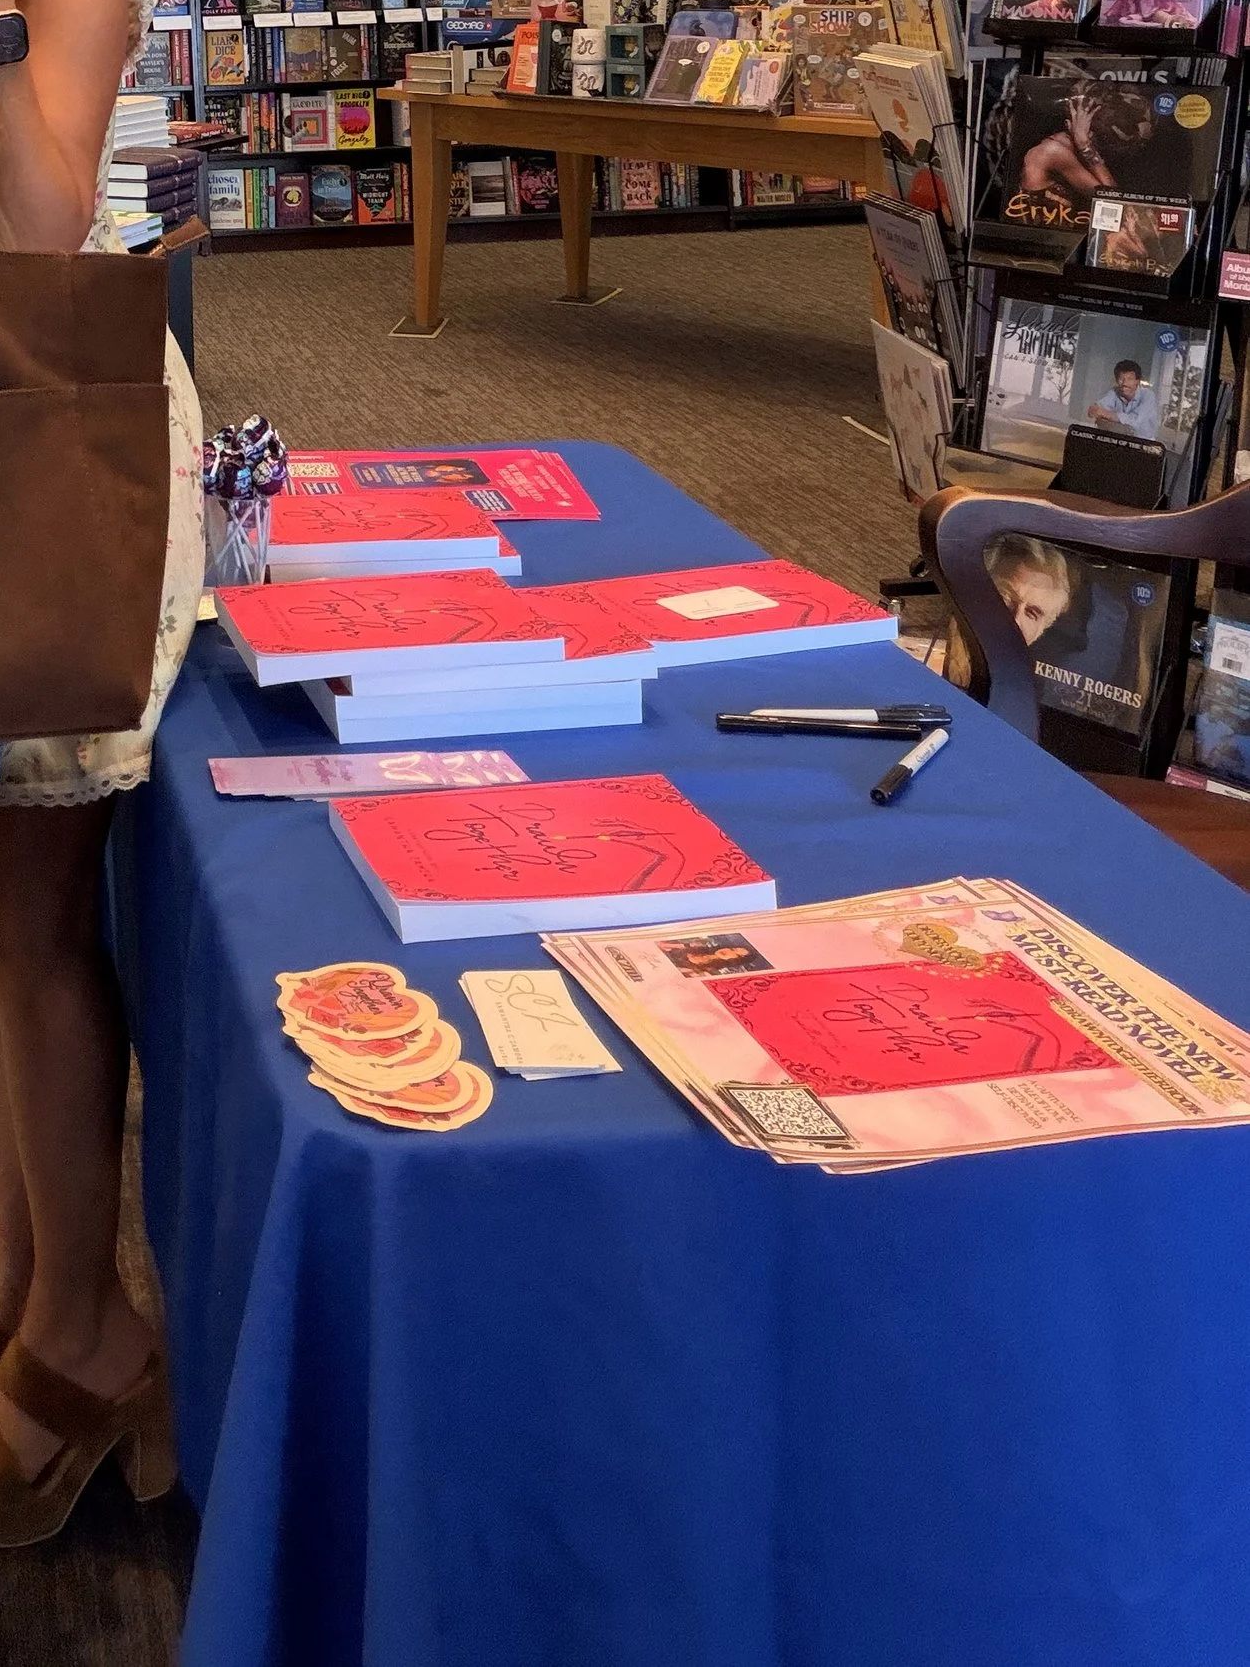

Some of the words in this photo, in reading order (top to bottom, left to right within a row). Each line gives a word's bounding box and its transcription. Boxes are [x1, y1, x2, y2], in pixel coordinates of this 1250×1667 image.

[820, 10, 855, 22] SHIP
[1002, 5, 1074, 20] MADONNA
[446, 20, 485, 30] GEOMAG
[215, 45, 237, 56] DICE
[208, 184, 240, 196] family
[626, 192, 653, 202] BACK
[1005, 192, 1091, 225] Eryka
[1226, 263, 1250, 273] Albu
[1034, 661, 1082, 689] KENNY
[1083, 676, 1142, 709] ROGERS
[1010, 933, 1130, 1024] MUST-READ
[1120, 1022, 1205, 1084] NOVEL
[1027, 928, 1139, 1007] DISCOVER
[1128, 1006, 1188, 1042] THE
[1180, 1040, 1246, 1083] NEW
